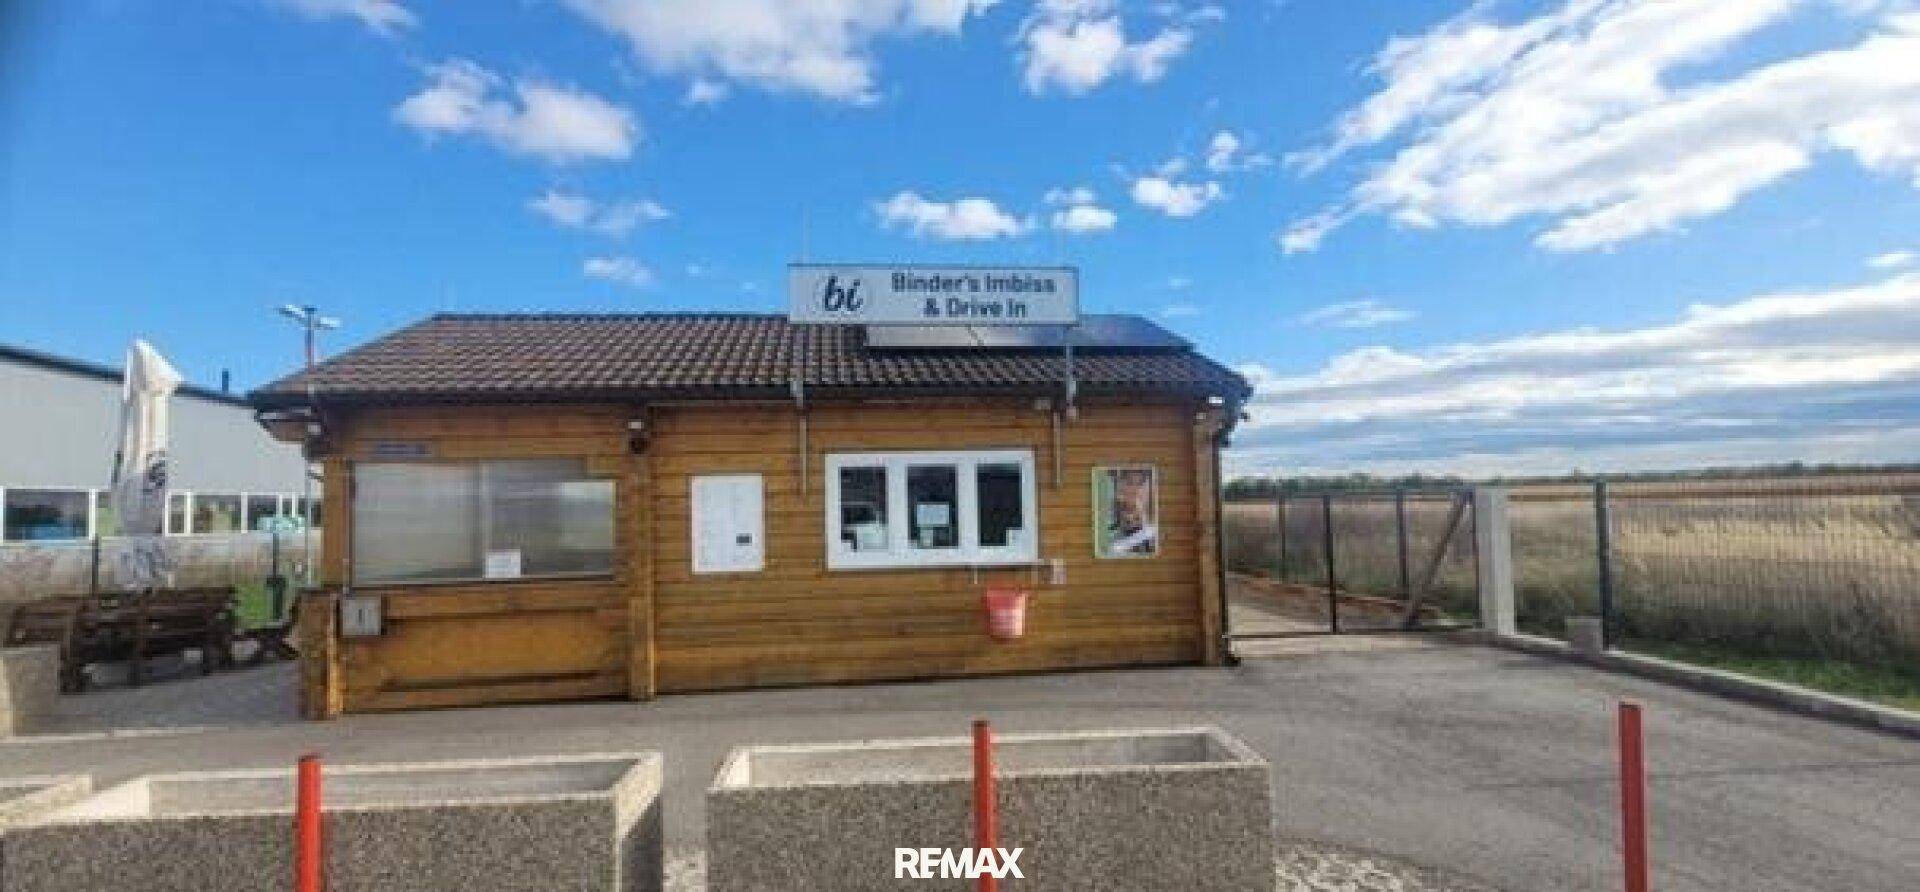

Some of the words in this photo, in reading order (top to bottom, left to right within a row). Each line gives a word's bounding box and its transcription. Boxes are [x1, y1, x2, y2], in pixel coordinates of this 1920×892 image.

[824, 274, 863, 311] bi
[891, 272, 979, 293] Binder's
[986, 273, 1056, 293] Imbiss
[923, 298, 940, 317] &
[947, 298, 1002, 318] Drive
[1006, 299, 1027, 318] In
